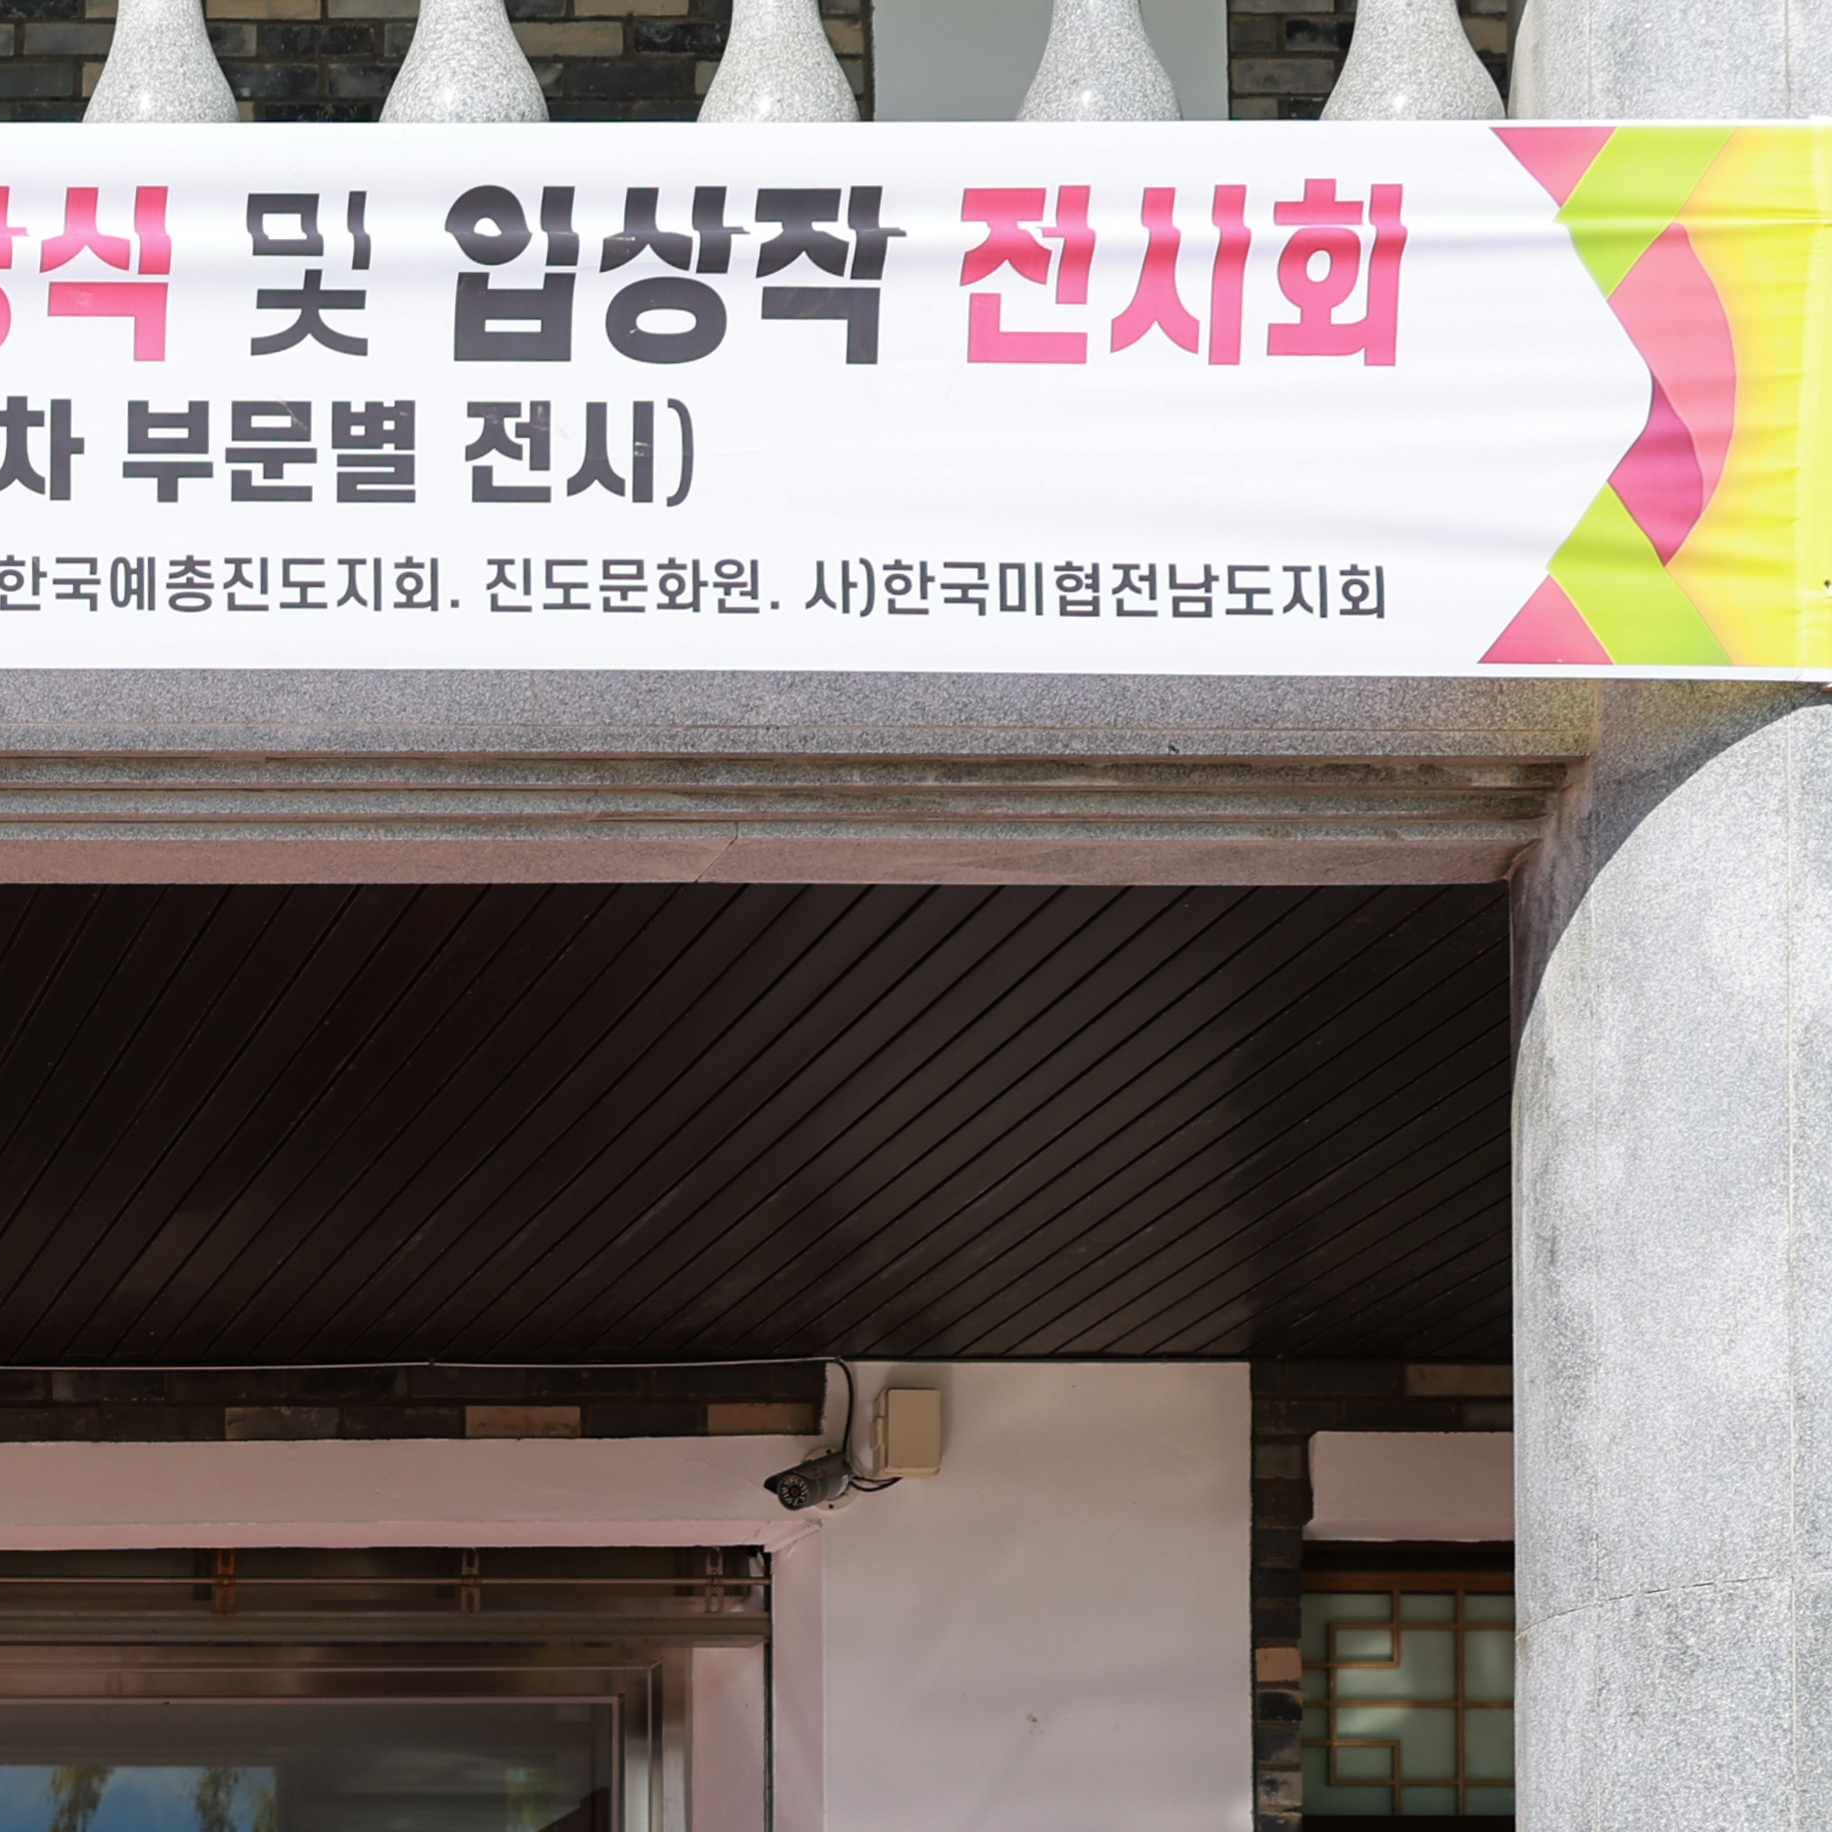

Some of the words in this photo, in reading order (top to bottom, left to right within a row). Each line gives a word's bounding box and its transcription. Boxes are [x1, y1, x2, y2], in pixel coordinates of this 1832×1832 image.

[247, 191, 370, 357] 및
[445, 185, 907, 365] 입상작
[960, 179, 1408, 367] 전시회
[122, 400, 416, 504] 부문별
[465, 398, 694, 508] 전시)
[487, 557, 780, 614] 진도문화원.
[806, 558, 1387, 619] 사)한국미협전남도지회
